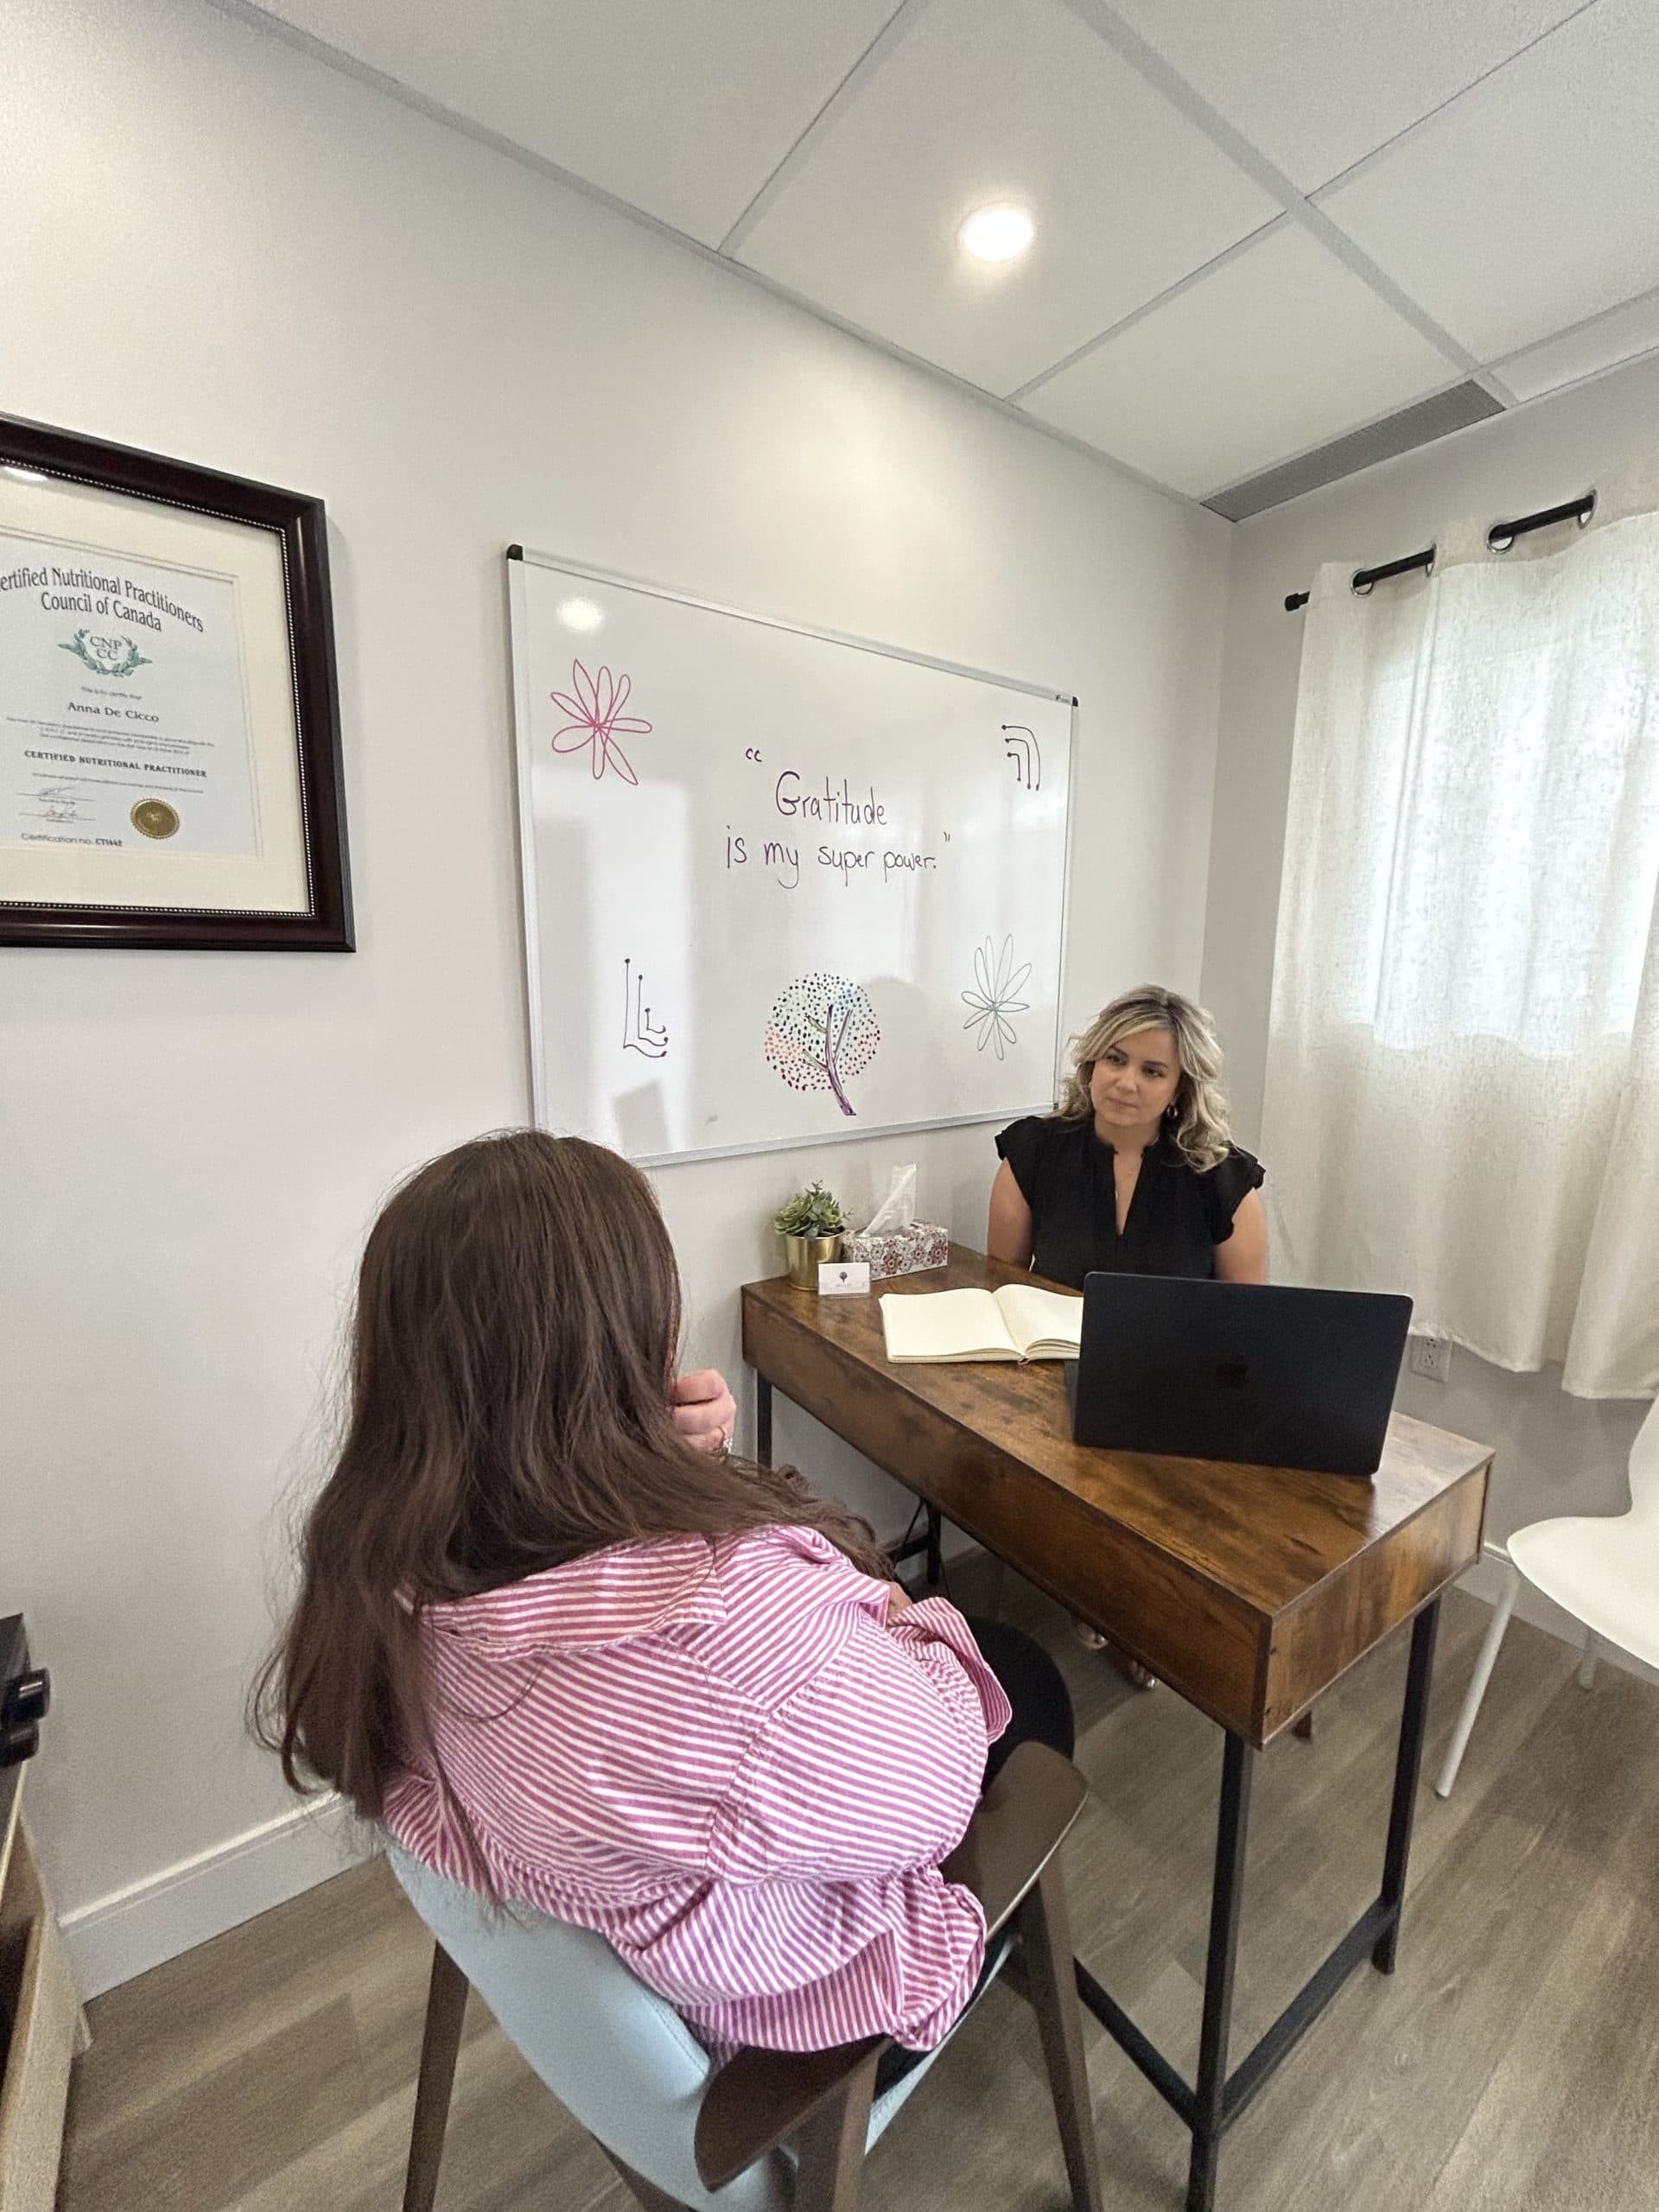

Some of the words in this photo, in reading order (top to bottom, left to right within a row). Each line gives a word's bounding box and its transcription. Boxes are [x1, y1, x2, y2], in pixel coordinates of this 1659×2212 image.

[0, 567, 48, 591] ertified
[52, 568, 121, 594] Nutritional
[125, 580, 204, 632] Practitioners
[41, 592, 91, 611] Council
[96, 597, 109, 615] of
[113, 601, 162, 632] Canada
[89, 635, 122, 650] CNP
[97, 649, 118, 661] CC
[67, 702, 100, 715] Anna
[105, 707, 121, 717] De
[24, 750, 75, 762] CERTIFIED
[79, 756, 141, 770] NUTRITIONAL
[143, 764, 207, 778] PRACTITIONER
[775, 771, 887, 825] Gratitude
[727, 825, 747, 868] is
[764, 842, 799, 889] my
[817, 846, 875, 887] super
